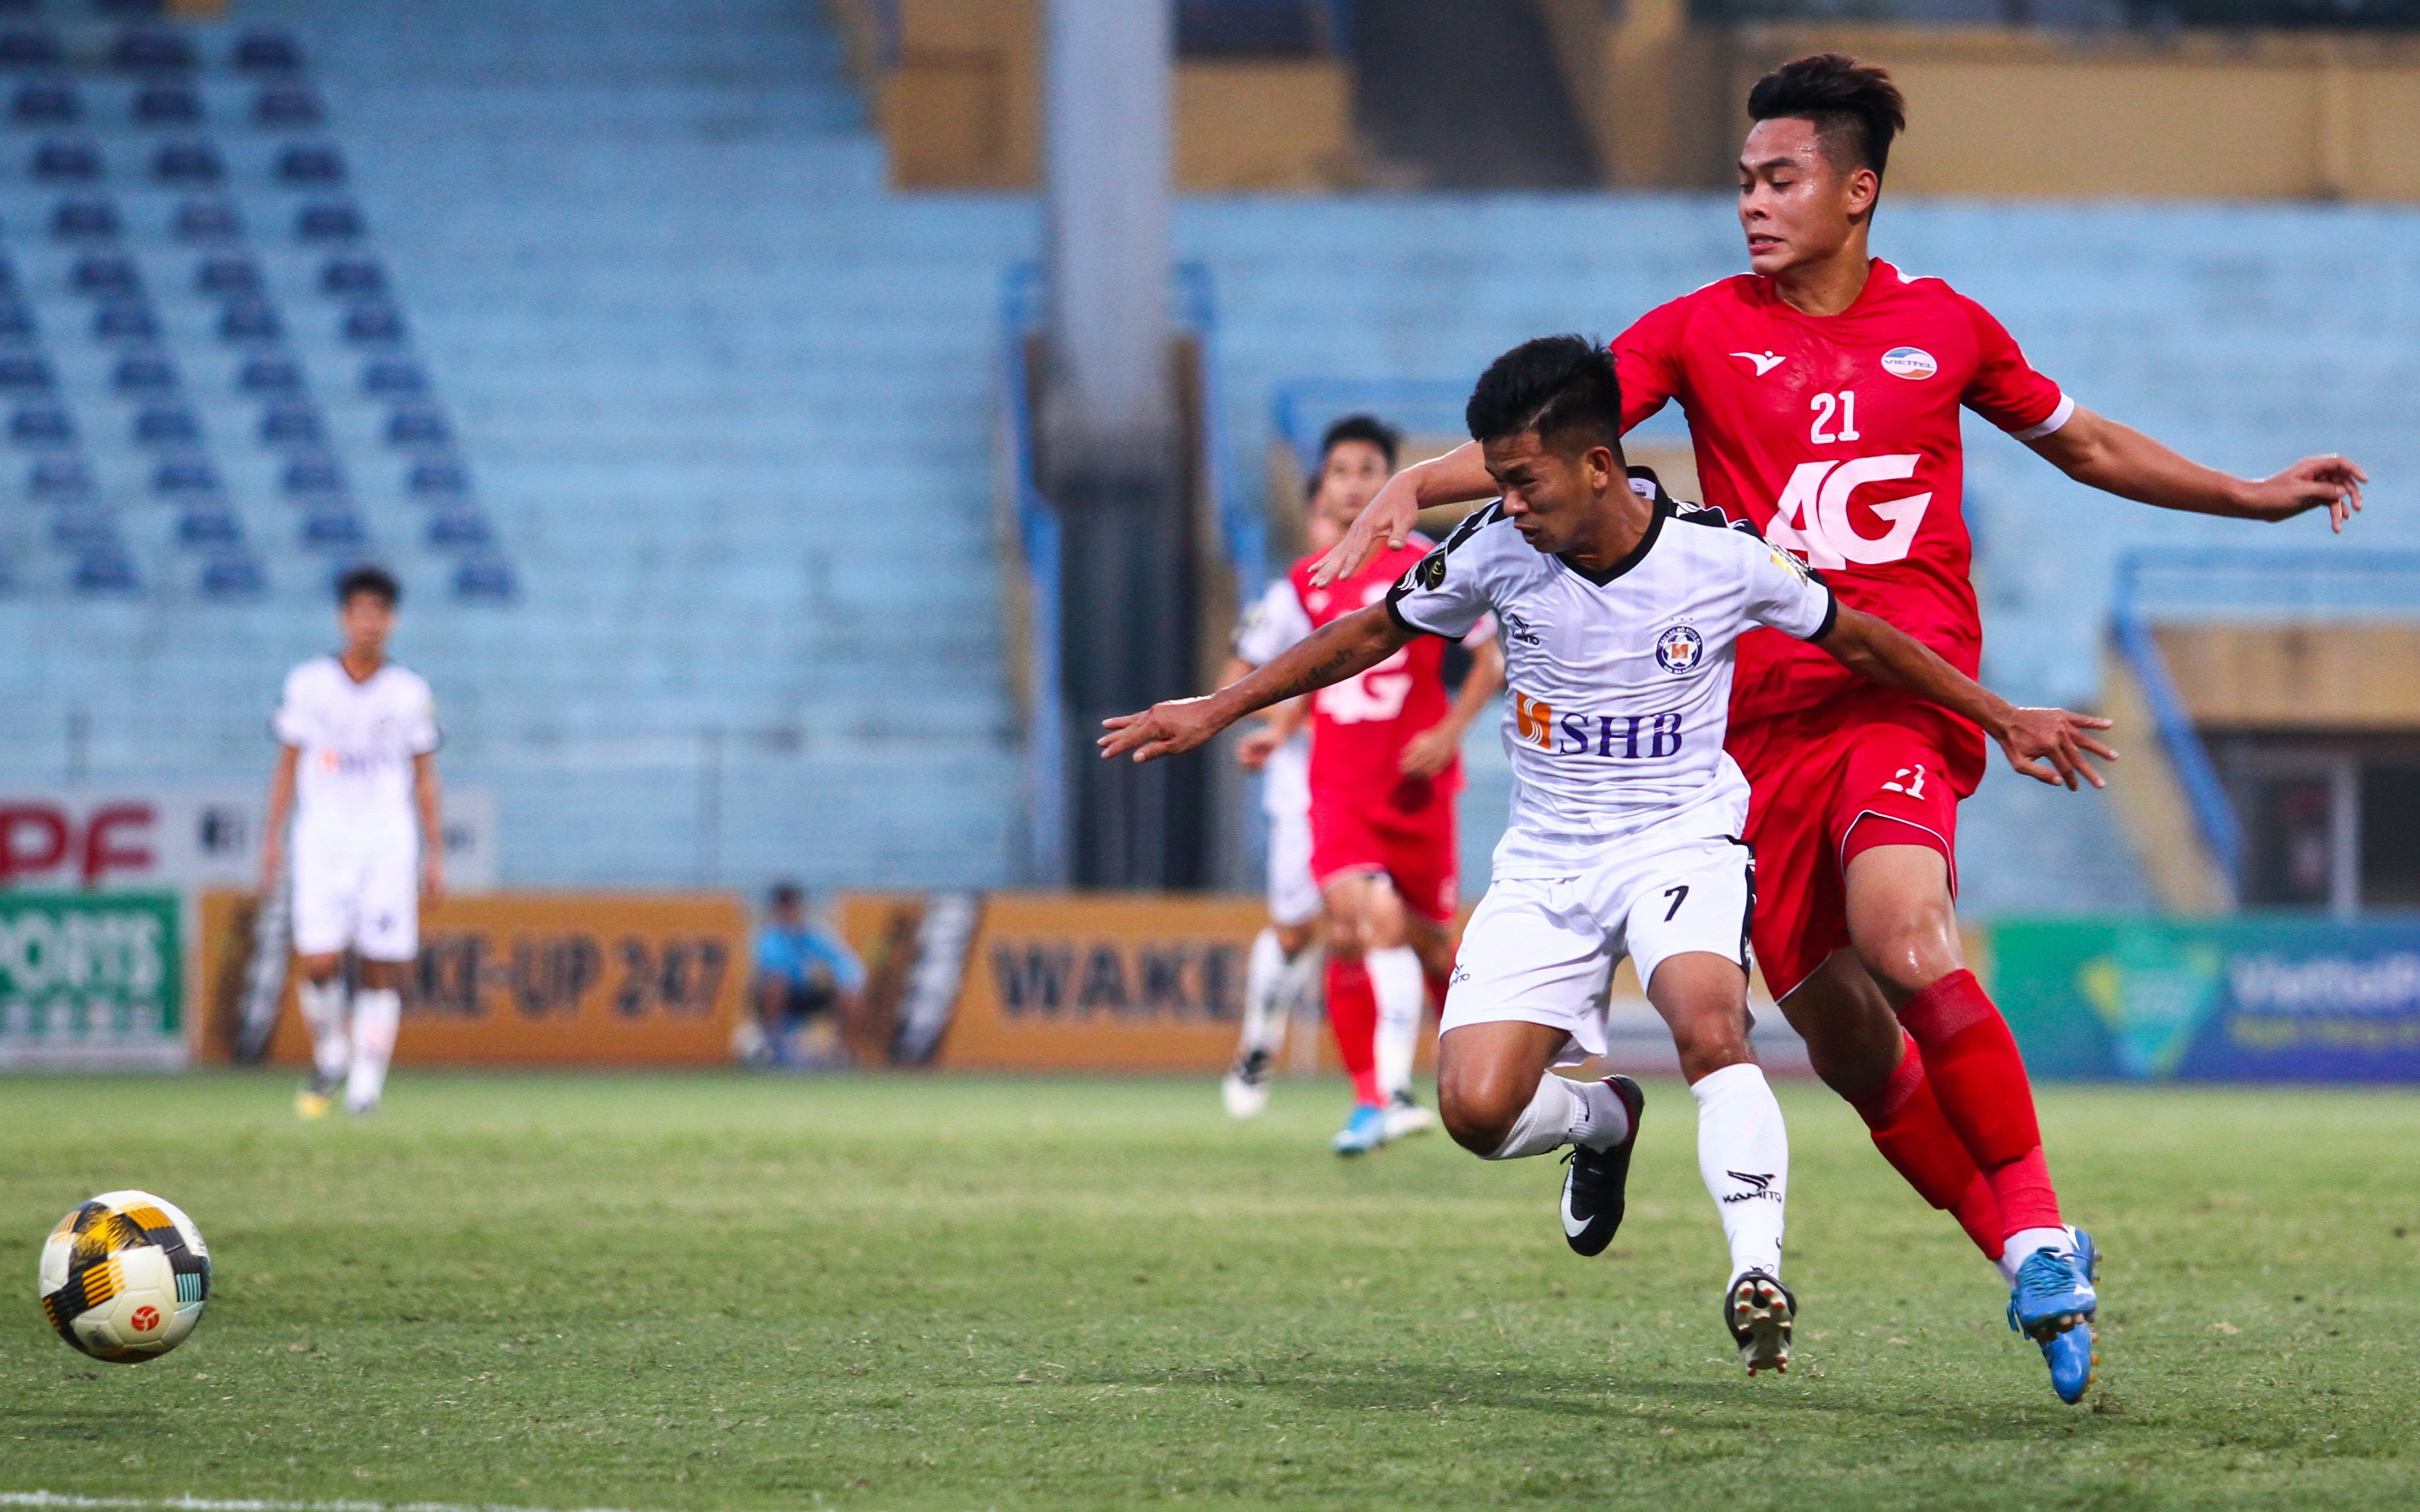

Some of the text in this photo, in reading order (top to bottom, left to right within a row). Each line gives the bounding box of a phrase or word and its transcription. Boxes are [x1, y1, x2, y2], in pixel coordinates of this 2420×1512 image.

[1810, 390, 1860, 445] 21
[1764, 453, 1933, 571] AG
[1560, 712, 1682, 759] SHB
[1664, 885, 1690, 923] 7
[1722, 1190, 1782, 1204] KAMITO
